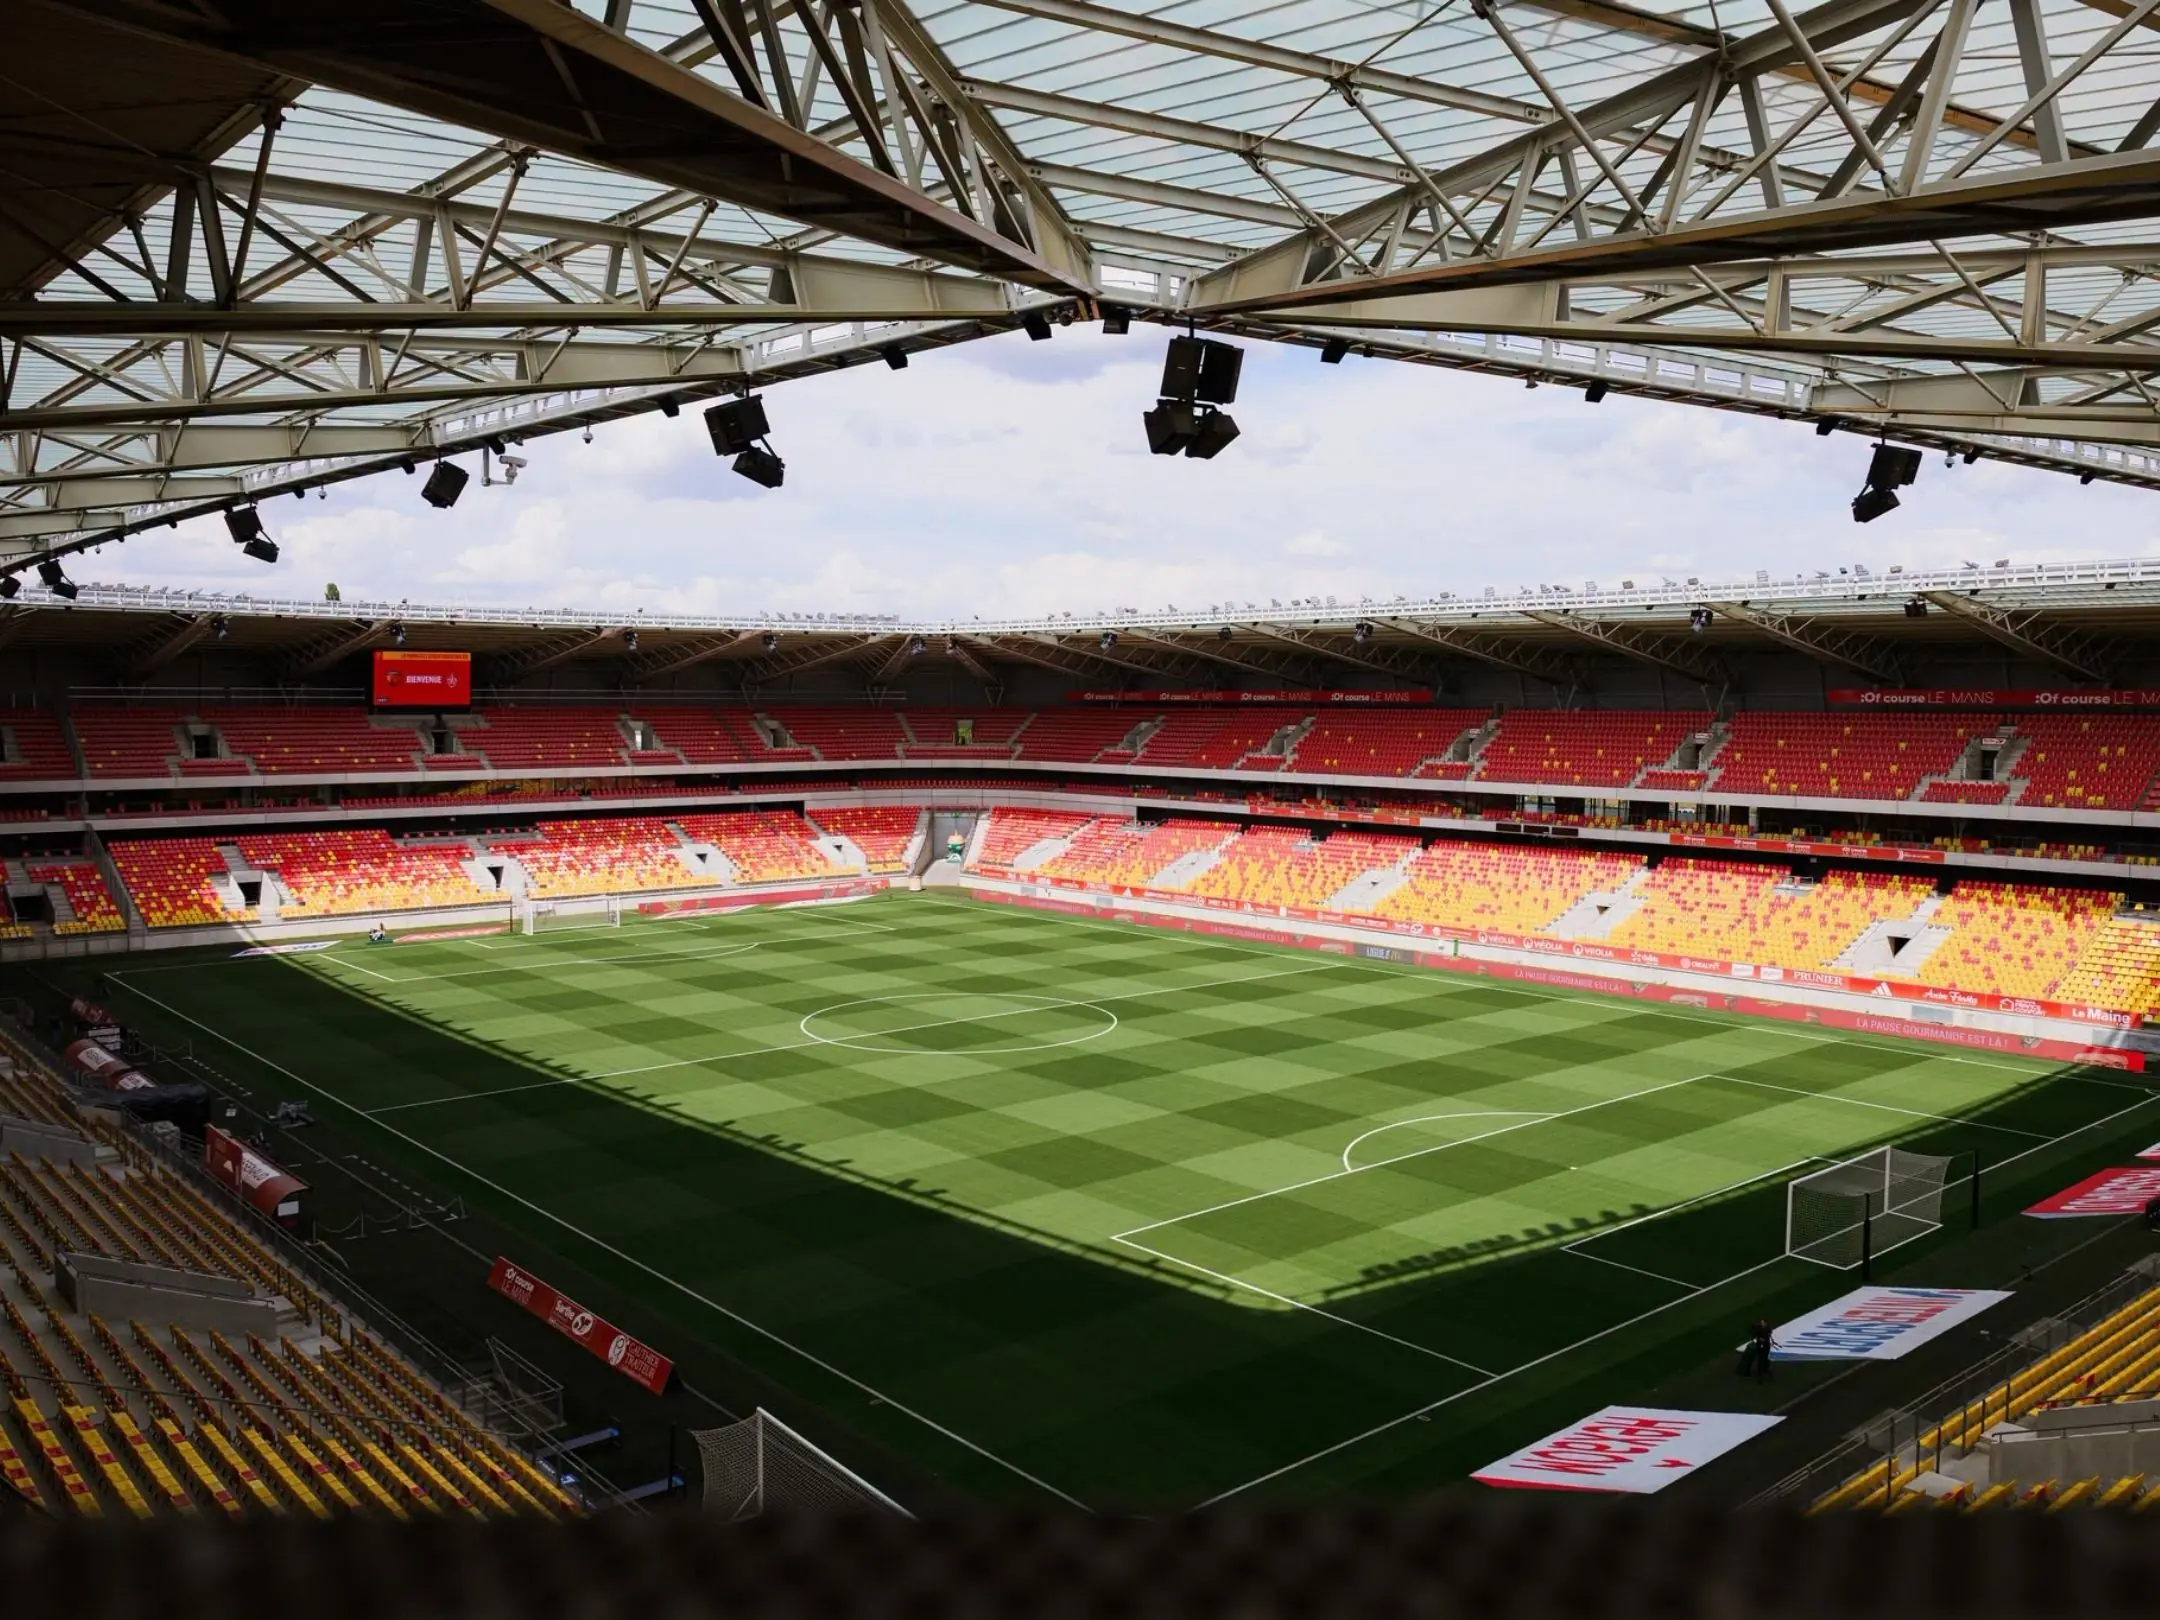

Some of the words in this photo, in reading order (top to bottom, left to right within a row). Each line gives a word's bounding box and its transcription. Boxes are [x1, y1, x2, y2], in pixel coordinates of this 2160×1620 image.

[406, 675, 442, 684] BIENVENUE
[1371, 692, 1382, 701] LE
[1384, 692, 1410, 702] MANS
[1883, 695, 1926, 704] course
[1927, 691, 1945, 704] LE
[1951, 691, 1994, 704] MANS
[2061, 695, 2111, 704] course
[2113, 691, 2136, 705] LE
[1533, 938, 1564, 950] VEOLIA
[1584, 946, 1614, 958] VEOLIA
[1792, 970, 1843, 986] PRUNIER
[2072, 1007, 2085, 1018] Le
[2086, 1007, 2130, 1024] Maine
[1856, 1017, 1869, 1028] LA
[1871, 1020, 1901, 1033] PAUSE
[1902, 1024, 1965, 1041] GOURMANDE
[1967, 1033, 1987, 1045] EST
[514, 1275, 536, 1293] course
[555, 1299, 576, 1321] Sarthe
[1783, 1296, 1965, 1354] INTERSPORT
